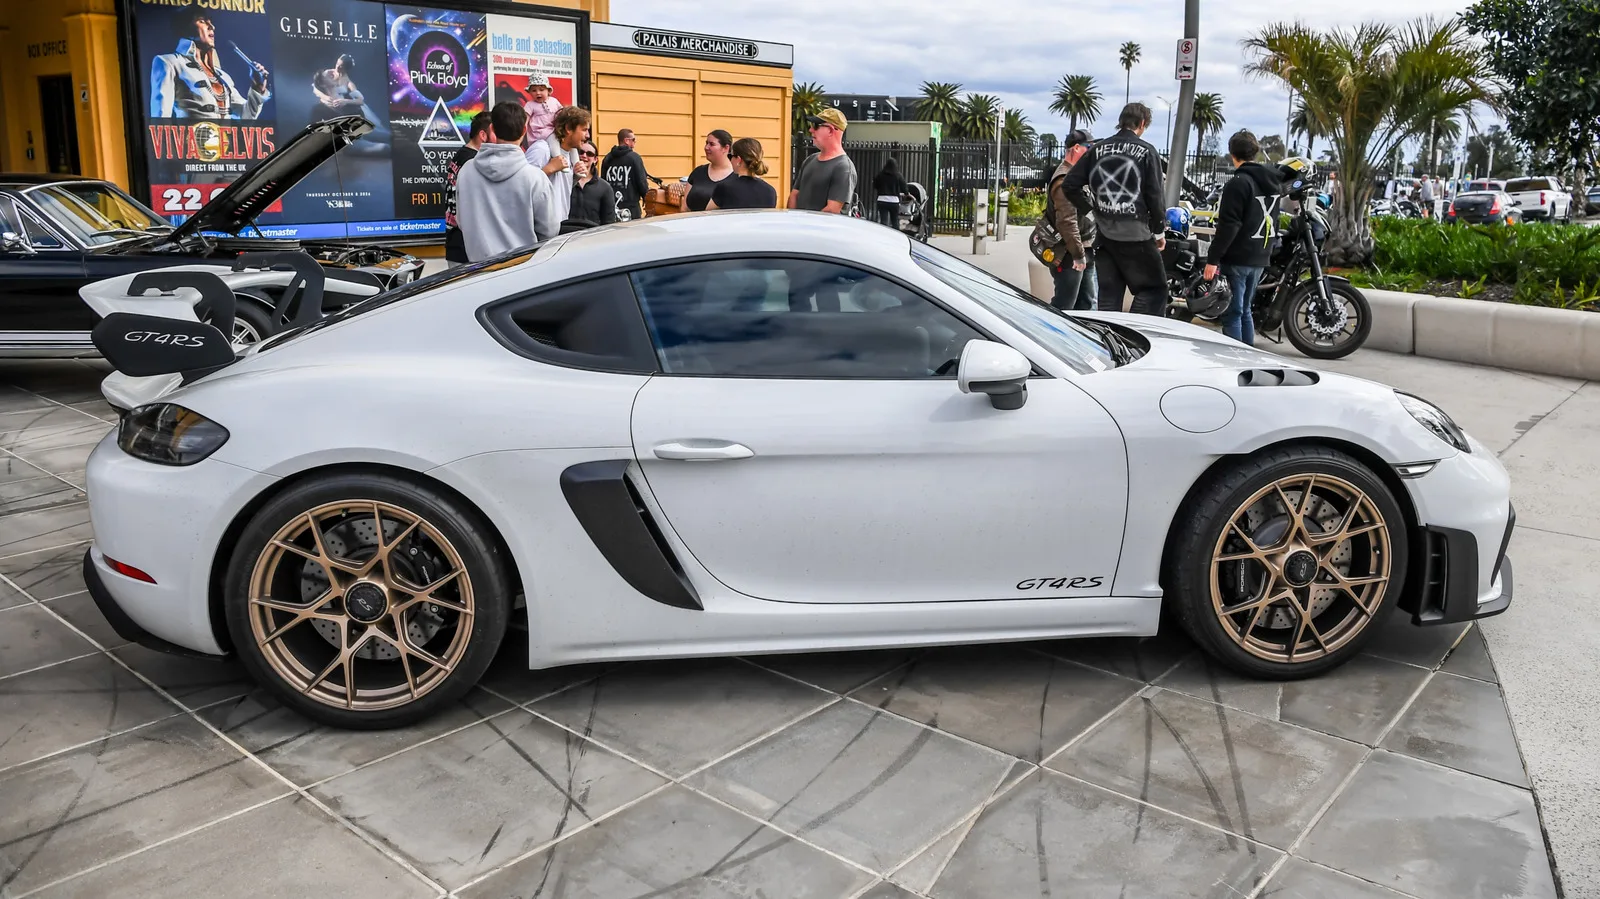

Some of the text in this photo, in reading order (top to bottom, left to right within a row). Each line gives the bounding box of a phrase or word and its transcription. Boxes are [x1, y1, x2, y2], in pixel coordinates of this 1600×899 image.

[280, 16, 378, 40] GISELLE
[42, 40, 68, 57] OFFICE
[492, 33, 572, 56] belle and sebastian
[643, 33, 749, 55] PALAIS MERCHANDISE
[426, 61, 453, 73] Echoes of
[410, 70, 469, 89] Pink Floyd
[148, 124, 276, 160] VIVA ELVIS
[424, 150, 436, 160] 60
[185, 163, 247, 172] DIRECT FROM THE UK
[421, 165, 439, 174] PINK
[162, 188, 203, 212] 22
[411, 192, 441, 205] FRI 11
[1251, 194, 1281, 239] X
[248, 228, 298, 238] ticetmaster
[399, 222, 441, 231] ticketmaster
